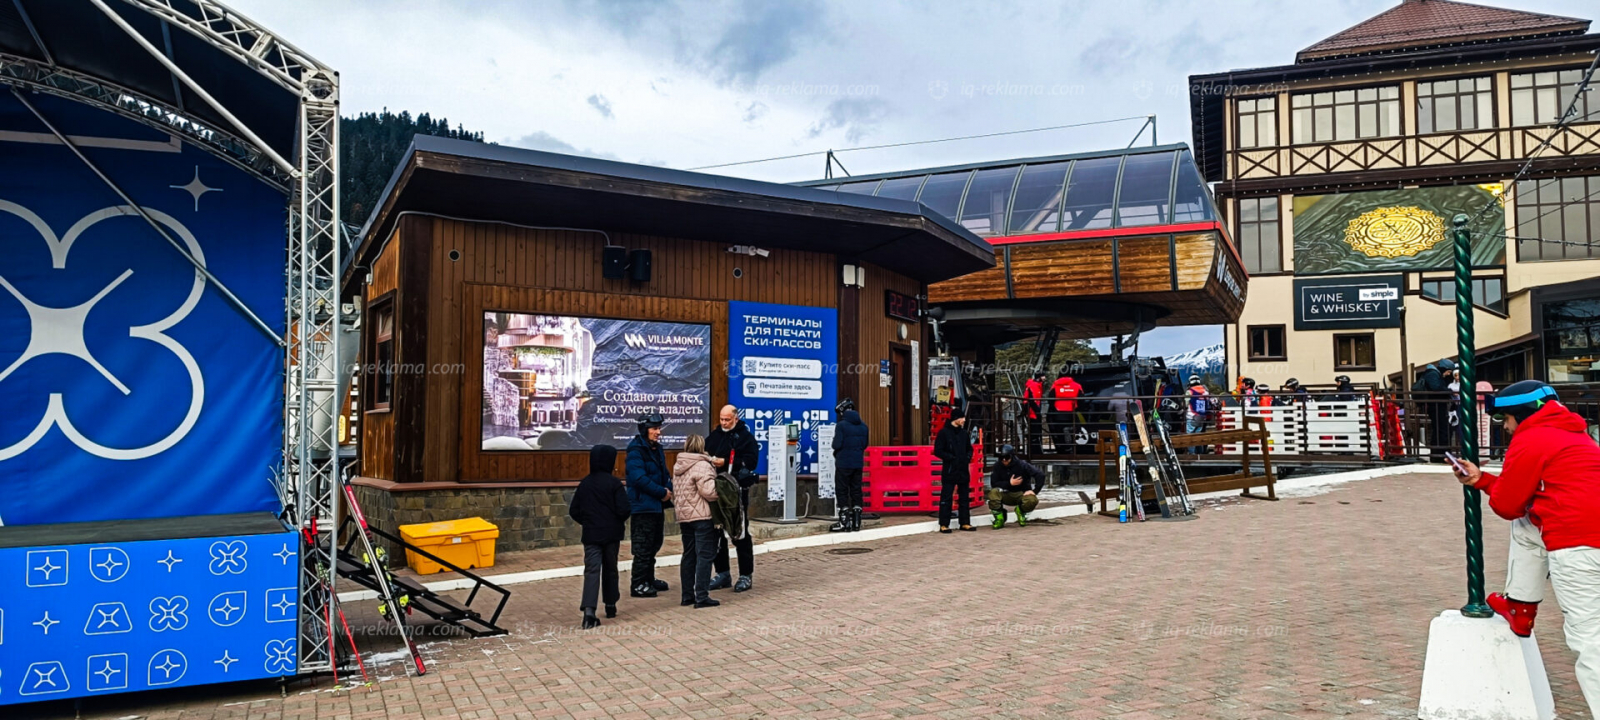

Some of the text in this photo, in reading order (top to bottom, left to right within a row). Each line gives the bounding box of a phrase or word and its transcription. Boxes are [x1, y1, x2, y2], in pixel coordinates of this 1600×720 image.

[1310, 293, 1344, 303] WINE
[1370, 290, 1394, 299] simple
[1310, 302, 1381, 314] & WHISKEY
[743, 315, 822, 328] ТЕРМИНАЛЫ
[744, 326, 821, 338] ДЛЯ ПЕЧАТИ
[647, 334, 704, 346] VILLA MONTE
[744, 337, 822, 349] СКИ-ПАССОВ
[759, 361, 782, 369] Купите
[783, 362, 811, 370] ски-пасс
[759, 382, 793, 390] Печатайте
[603, 389, 703, 404] Создано для тех,
[596, 405, 703, 417] кто умеет владеть
